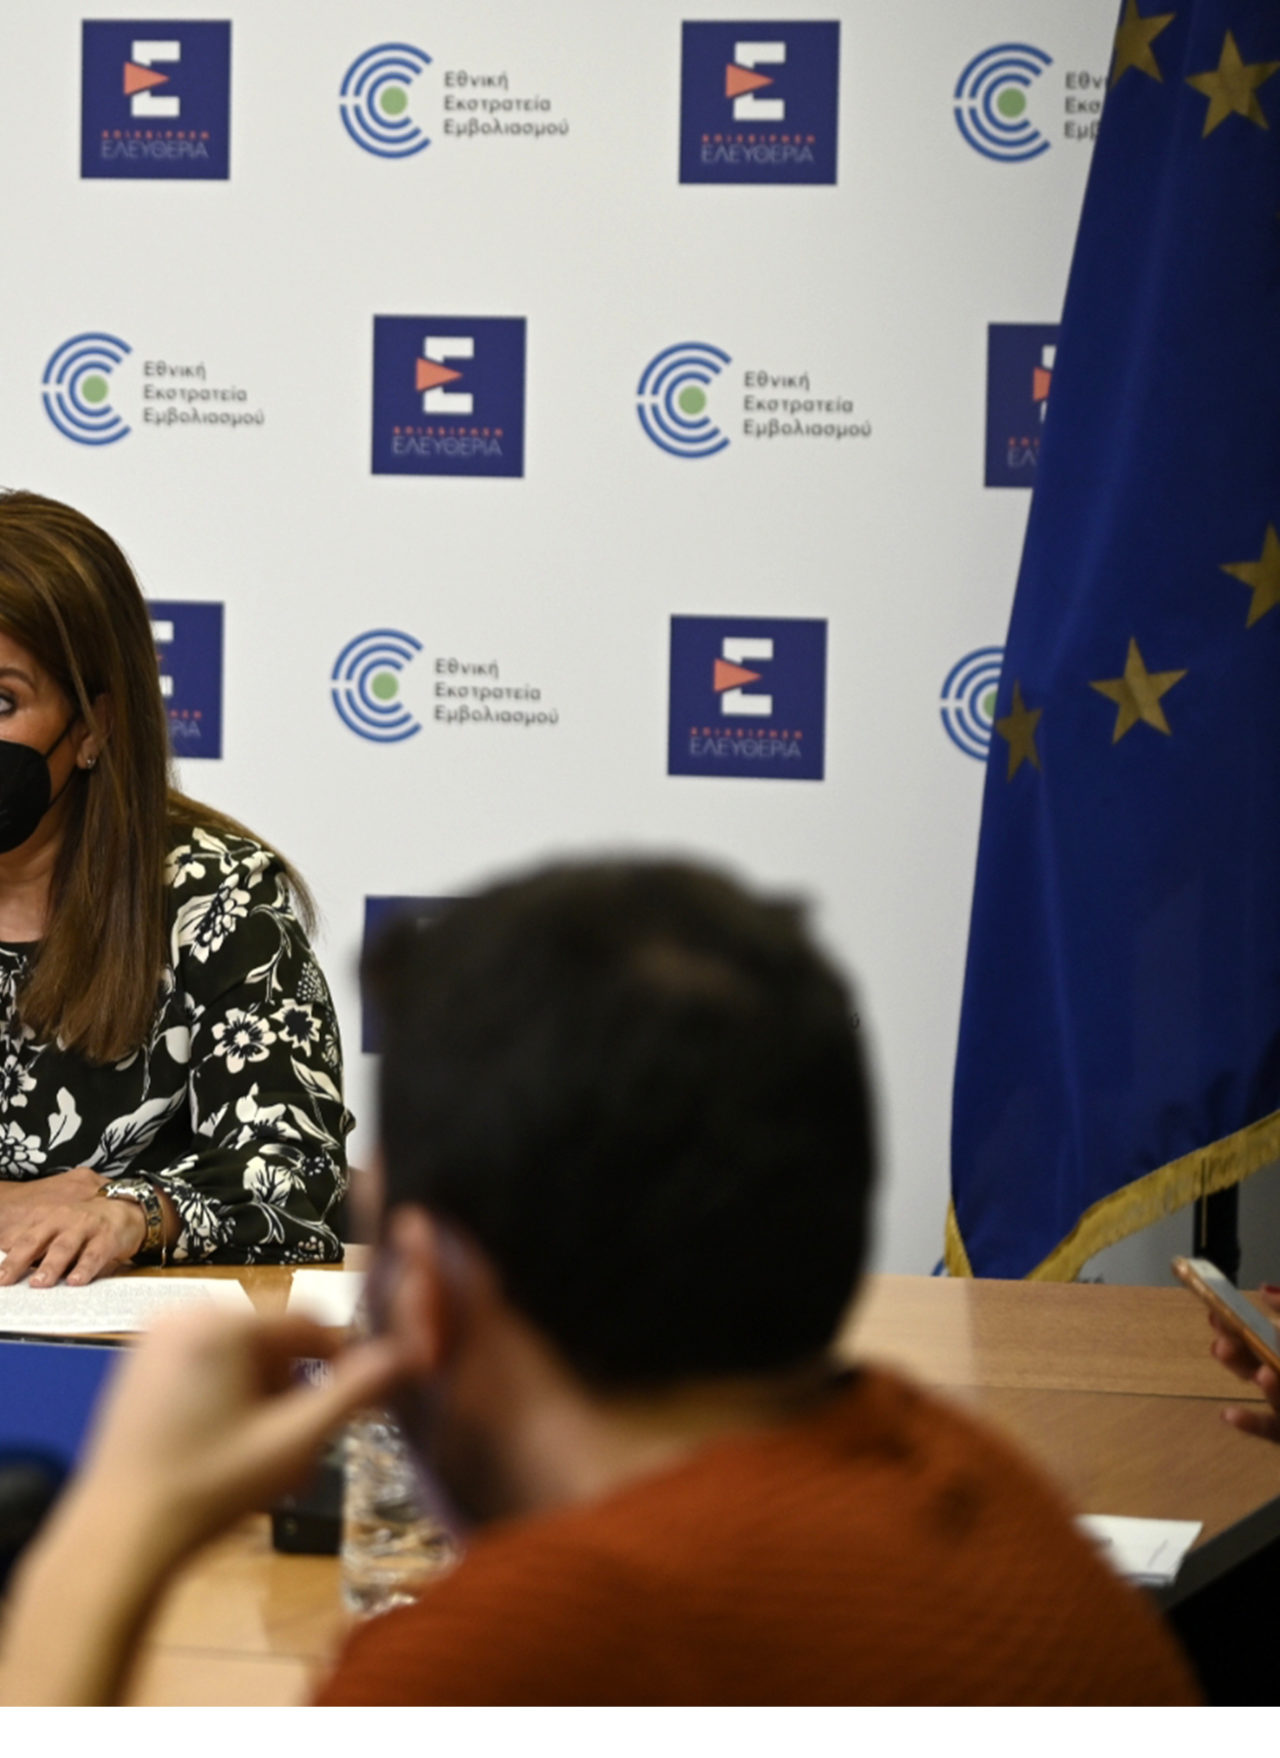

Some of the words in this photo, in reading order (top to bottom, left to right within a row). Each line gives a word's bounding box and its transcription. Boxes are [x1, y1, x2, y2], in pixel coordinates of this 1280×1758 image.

[443, 71, 509, 91] Εθνική
[1064, 71, 1106, 90] Εθν
[443, 95, 551, 115] Εκστρατεία
[443, 118, 570, 138] Εμβολιασμού
[142, 361, 206, 381] Εθνική
[743, 371, 810, 392] Εθνική
[142, 384, 248, 404] Εκστρατεία
[743, 395, 854, 416] Εκστρατεία
[142, 407, 265, 428] Εμβολιασμού
[743, 419, 872, 440] Εμβολιασμού
[433, 658, 499, 678] Εθνική
[433, 682, 541, 702] Εκστρατεία
[433, 705, 559, 726] Εμβολιασμού
